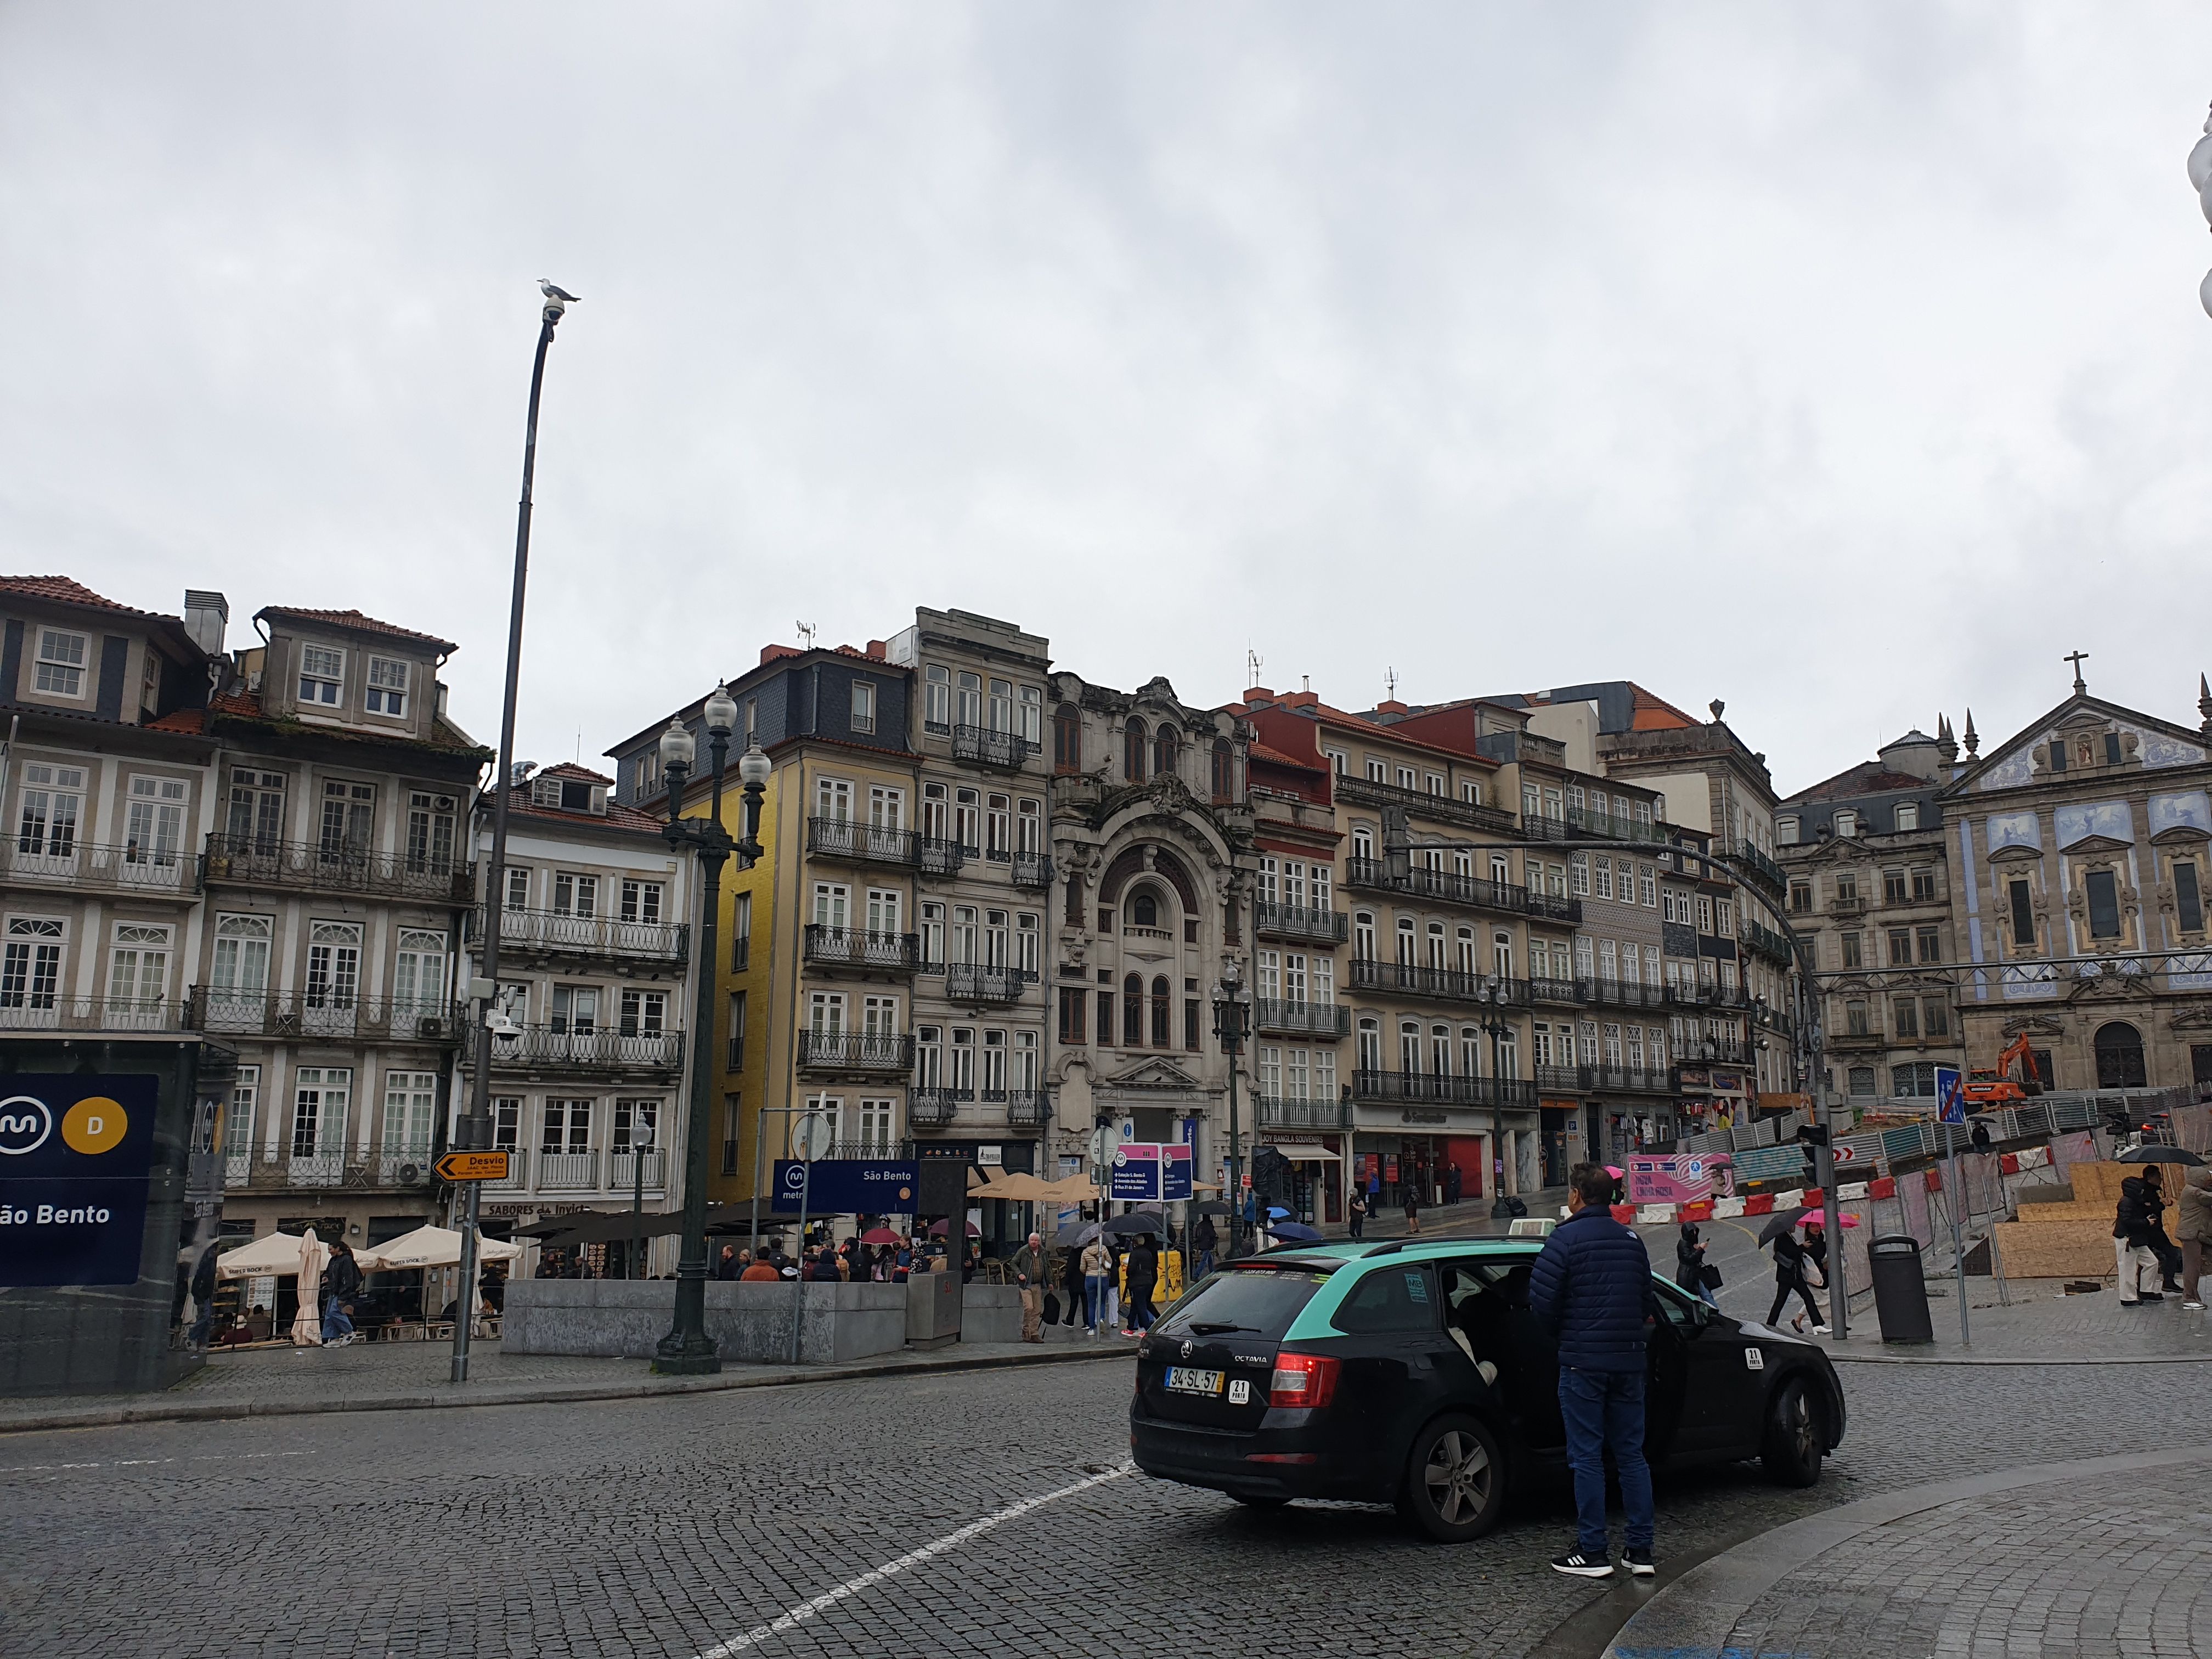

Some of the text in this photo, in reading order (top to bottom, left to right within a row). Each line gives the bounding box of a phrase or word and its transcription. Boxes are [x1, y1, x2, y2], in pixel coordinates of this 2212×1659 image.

[87, 1116, 103, 1135] D
[1273, 1135, 1294, 1143] BANGLA
[1295, 1135, 1323, 1143] SOUVENIRS
[470, 1156, 504, 1165] Desvio
[864, 1171, 911, 1180] São Bento
[0, 1205, 110, 1224] ão Bento
[489, 1205, 534, 1215] SABORES
[1234, 1355, 1267, 1363] OCTAVIA
[1750, 1350, 1758, 1359] 21
[1234, 1381, 1245, 1392] 21
